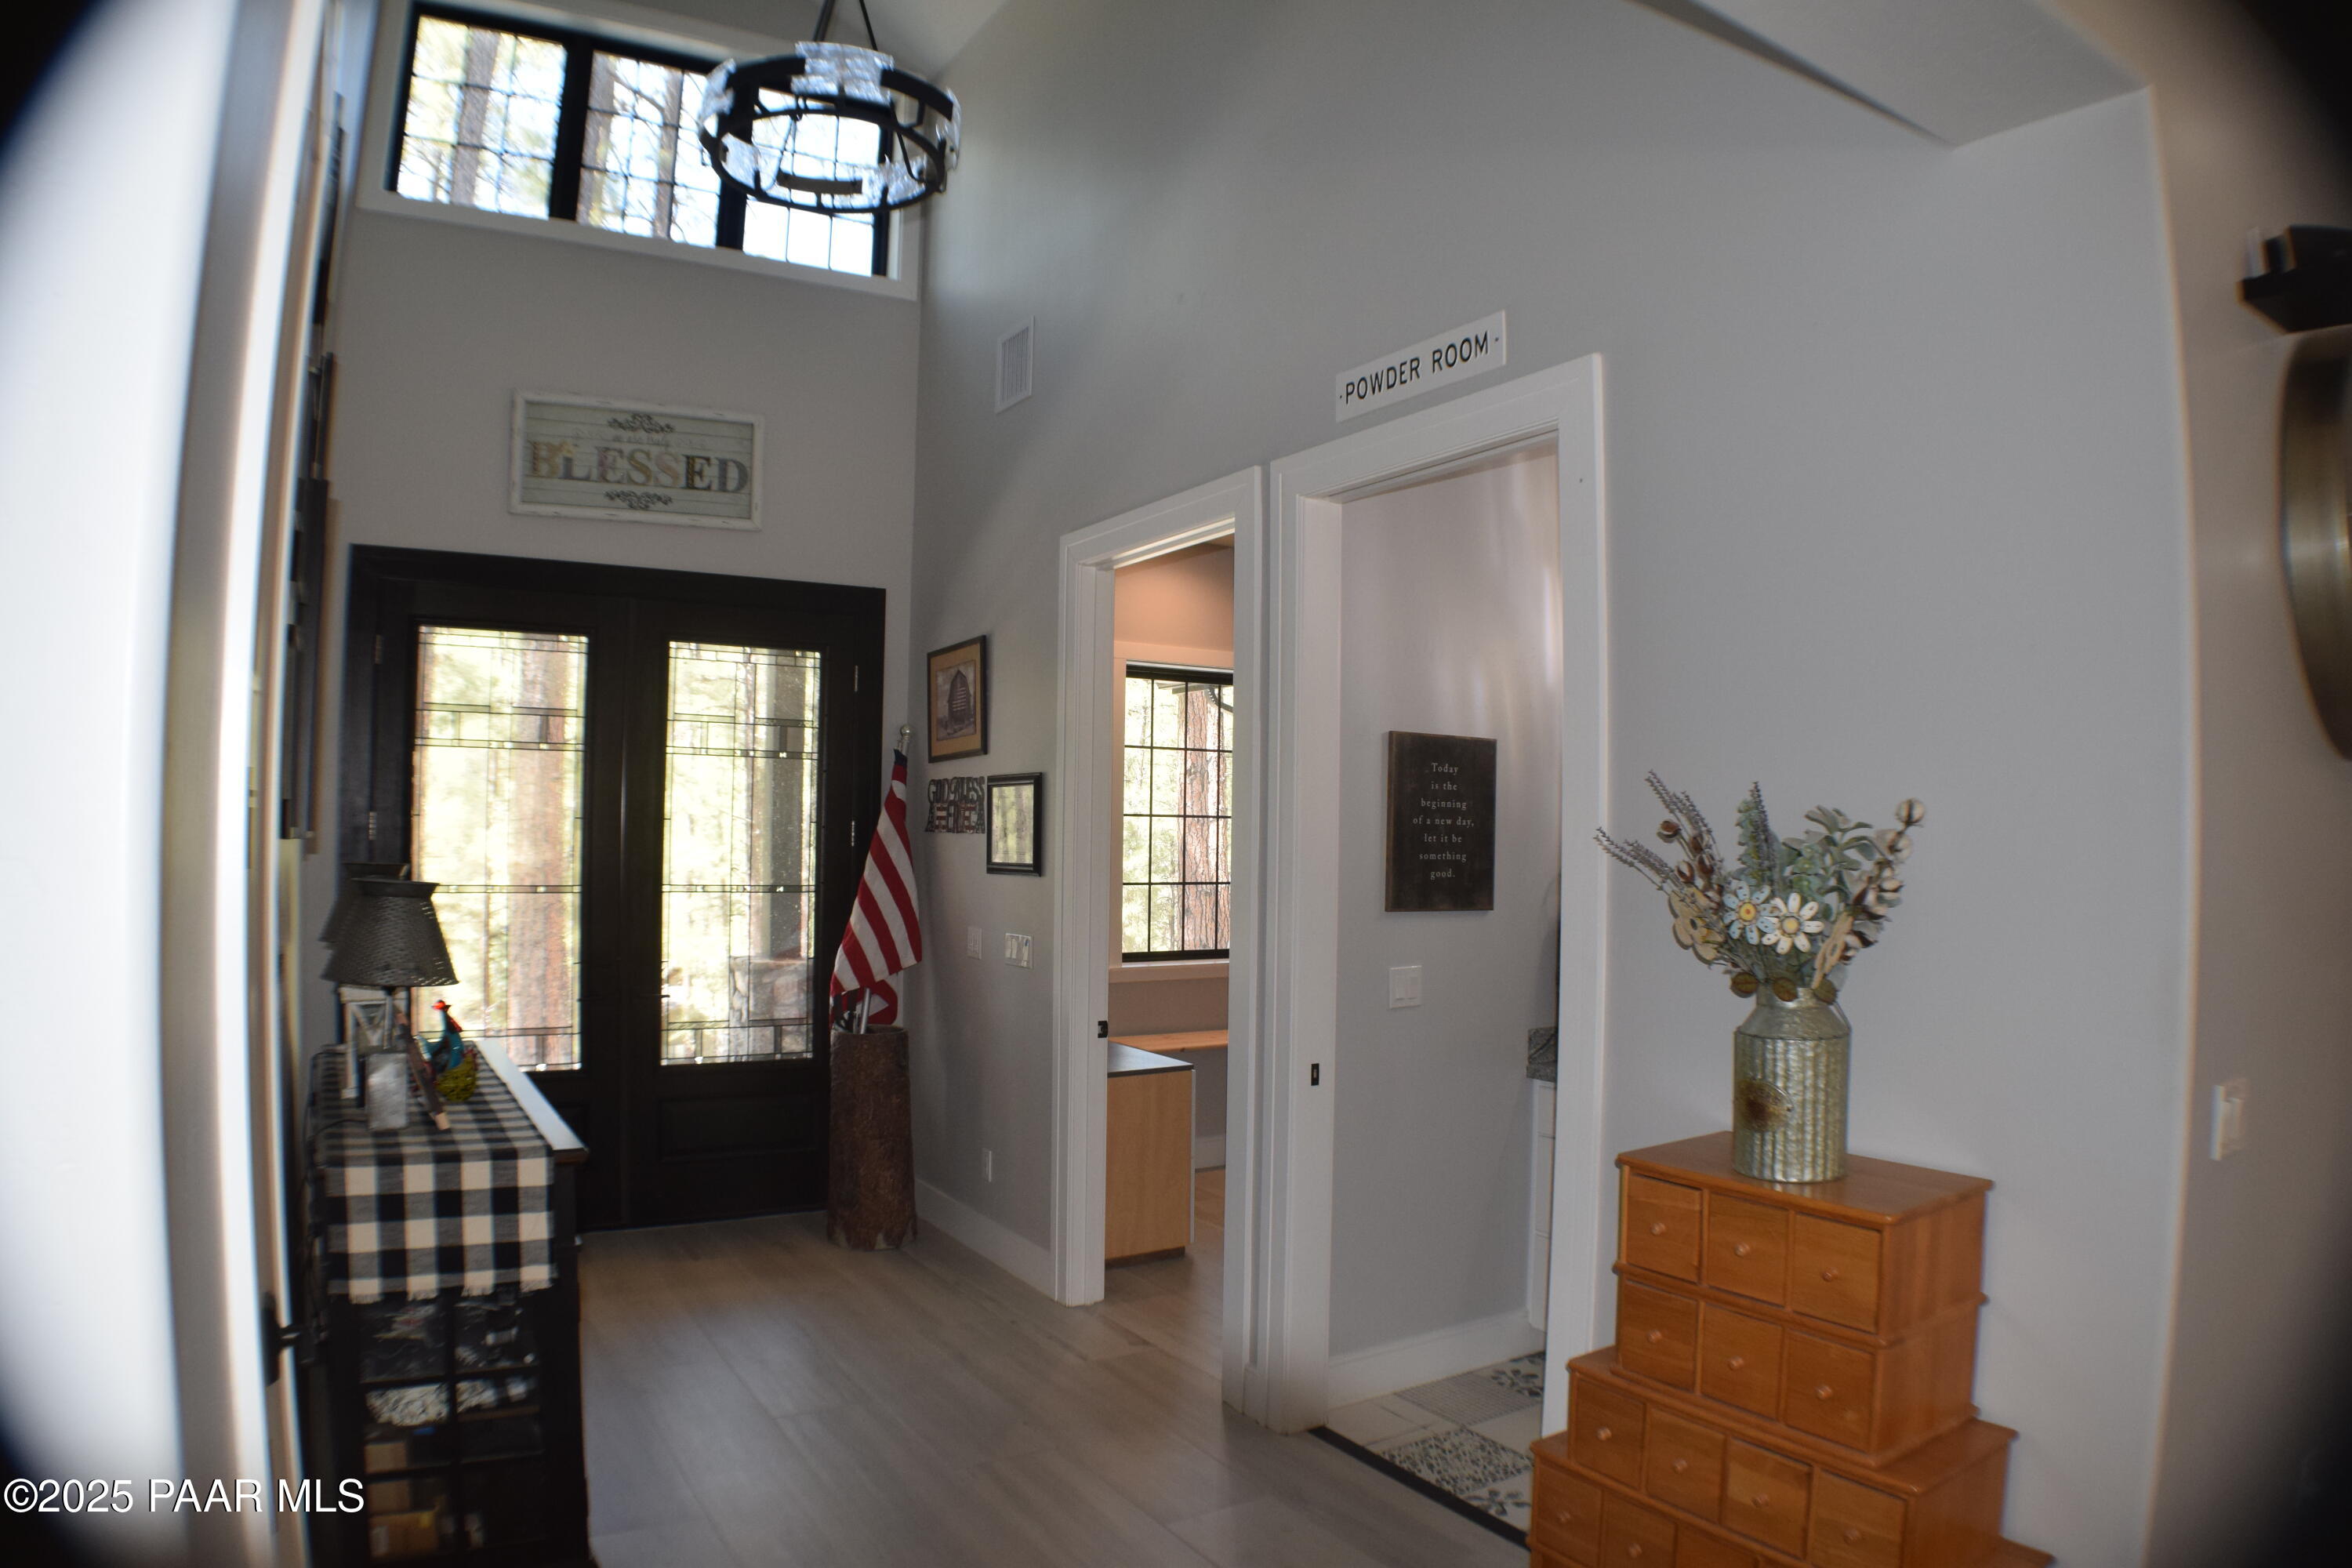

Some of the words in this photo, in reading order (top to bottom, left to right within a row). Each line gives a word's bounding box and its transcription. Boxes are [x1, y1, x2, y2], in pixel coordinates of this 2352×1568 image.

[1345, 357, 1421, 405] POWDER
[1432, 330, 1489, 373] ROOM
[528, 439, 749, 493] BLESSED
[1431, 762, 1459, 775] Today
[1430, 781, 1439, 790] is
[1443, 782, 1458, 790] the
[1421, 797, 1468, 810] beginning
[1413, 815, 1424, 825] of
[1456, 816, 1475, 828] day,
[1424, 833, 1436, 843] let
[1440, 833, 1448, 843] it
[1452, 833, 1462, 843] be
[1419, 851, 1467, 862] something
[1430, 868, 1456, 880] good.
